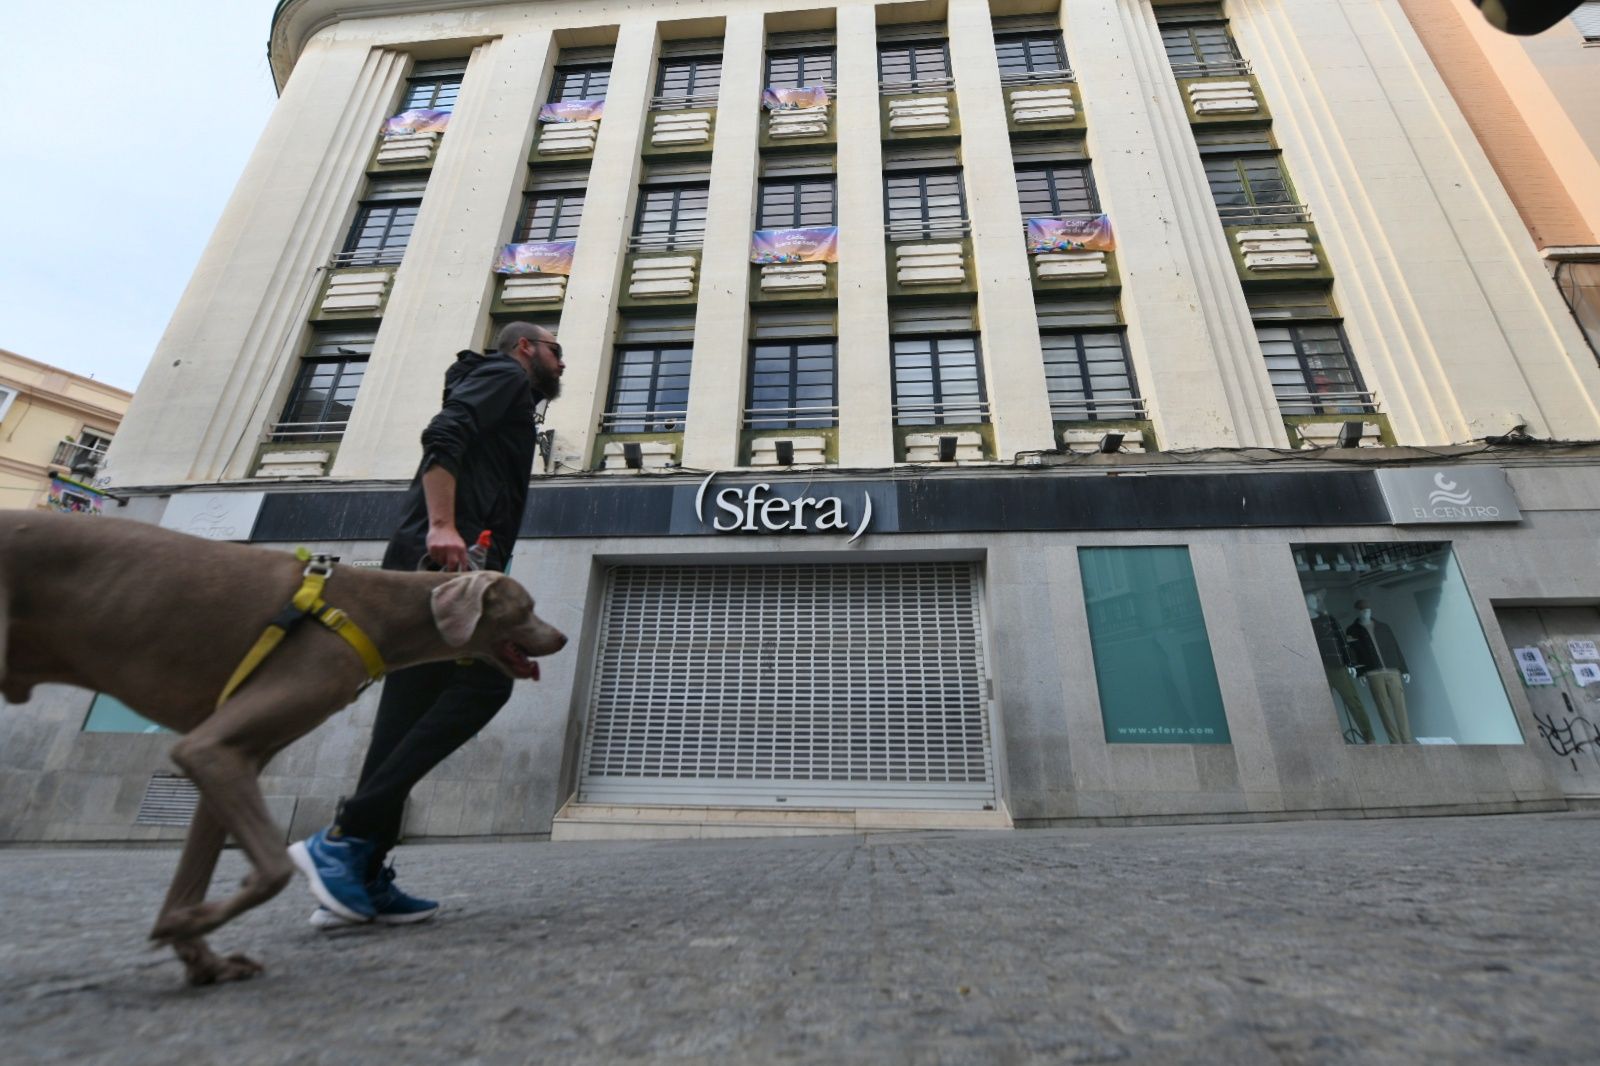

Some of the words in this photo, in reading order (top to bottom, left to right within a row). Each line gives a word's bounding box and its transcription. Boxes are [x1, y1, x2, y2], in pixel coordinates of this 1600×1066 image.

[1413, 507, 1431, 518] EL
[1433, 505, 1500, 518] CENTRO
[1118, 726, 1214, 735] www.sfera.com
